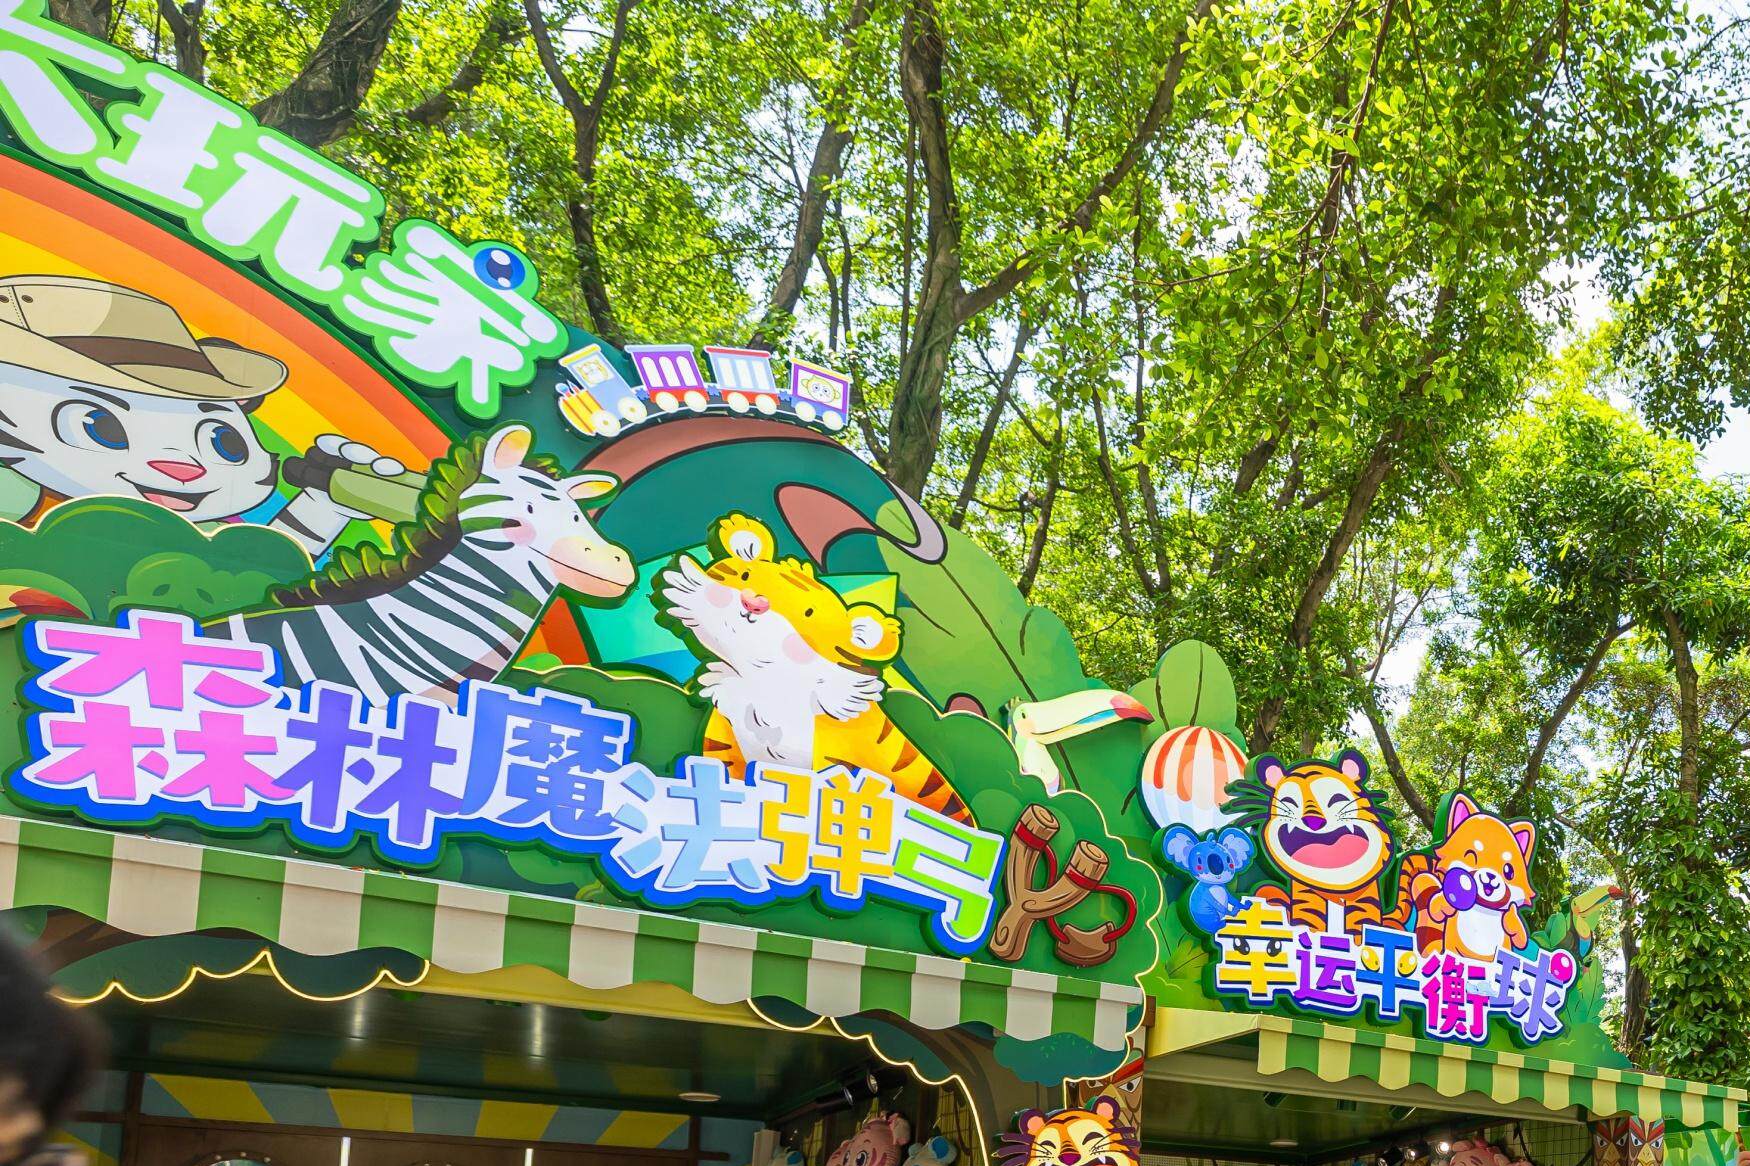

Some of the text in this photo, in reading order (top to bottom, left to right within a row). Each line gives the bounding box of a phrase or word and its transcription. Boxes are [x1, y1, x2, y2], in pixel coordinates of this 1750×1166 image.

[43, 615, 1004, 932] 森林魔法弹弓
[1216, 900, 1575, 1040] 幸运平衡球
